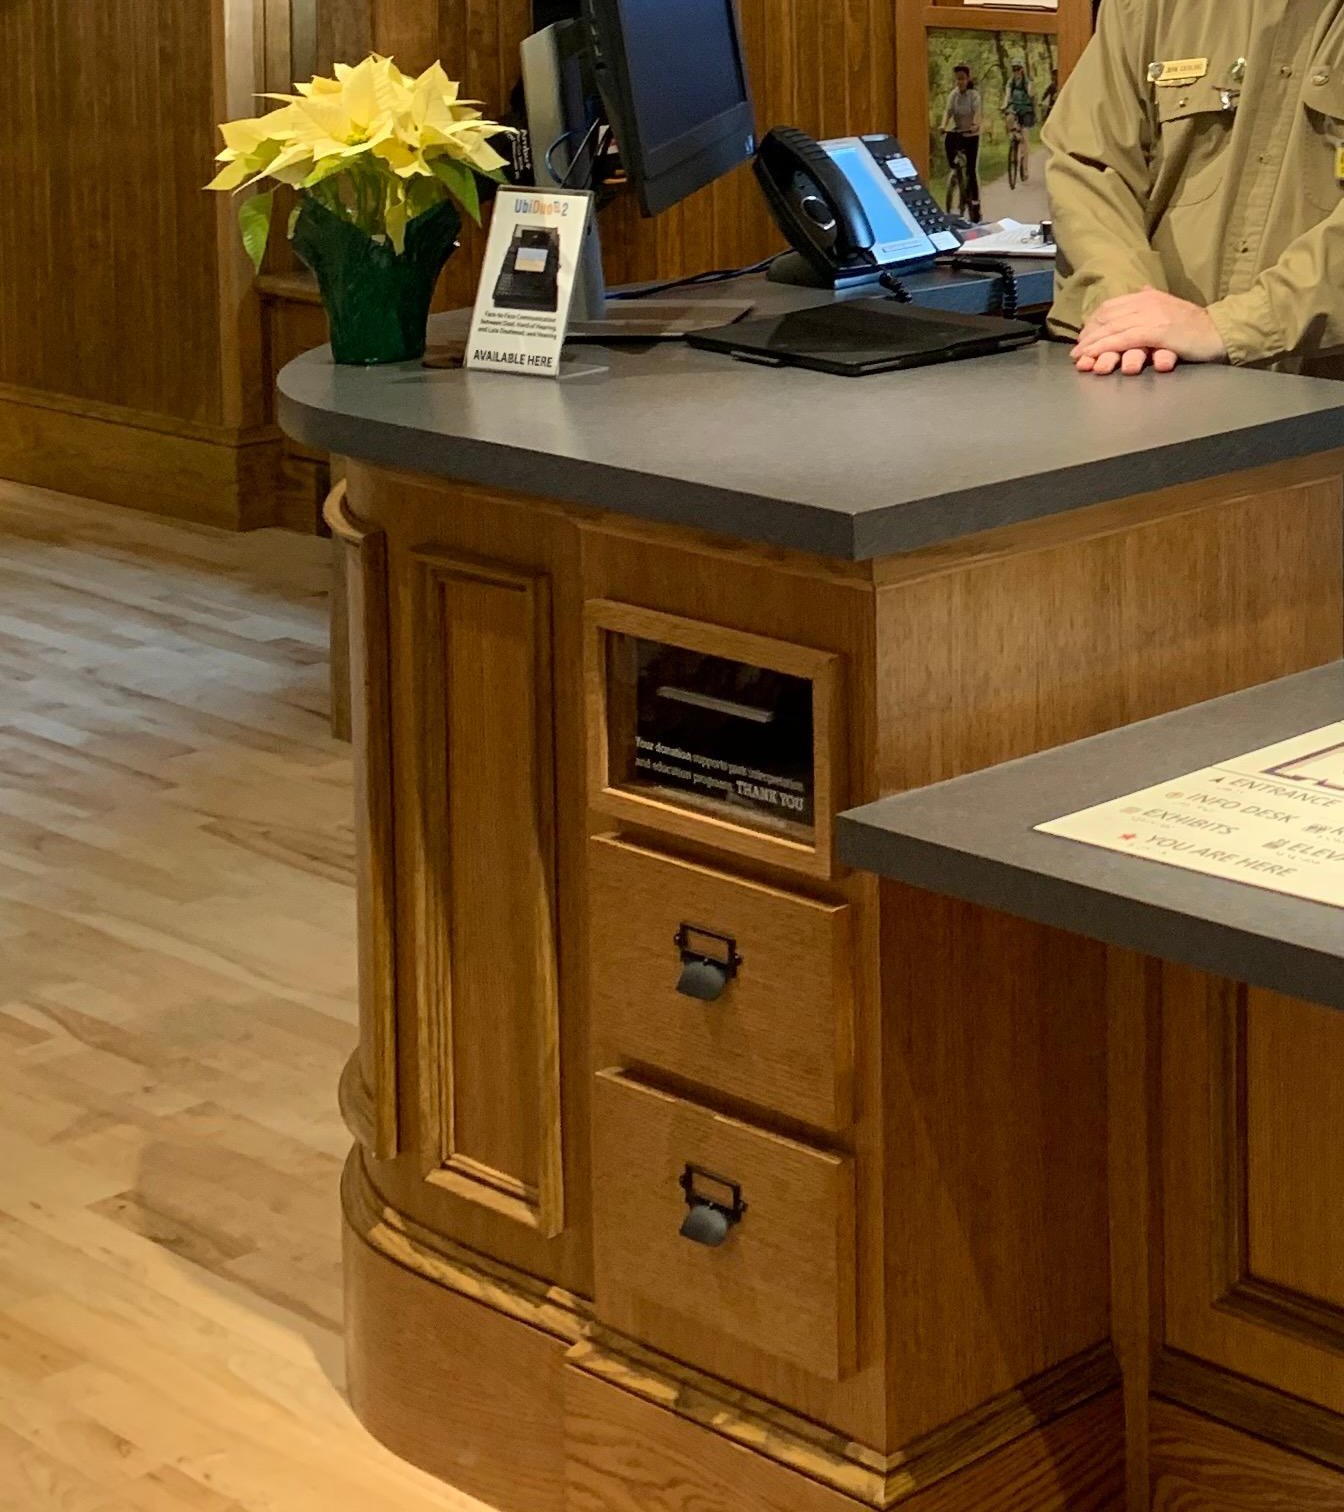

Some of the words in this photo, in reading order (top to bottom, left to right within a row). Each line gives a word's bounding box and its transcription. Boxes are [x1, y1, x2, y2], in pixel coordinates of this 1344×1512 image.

[561, 202, 569, 217] 2
[473, 349, 526, 366] AVAILABLE
[527, 354, 553, 368] HERE
[735, 779, 778, 805] THANK
[778, 792, 804, 812] YOU
[1229, 778, 1342, 808] ENTRANCE
[1143, 808, 1240, 836] EXHIBITS
[1186, 793, 1242, 811] INFO
[1240, 804, 1301, 824] DESK
[1146, 834, 1198, 857] YOU
[1196, 845, 1241, 867] ARE
[1235, 855, 1299, 878] HERE
